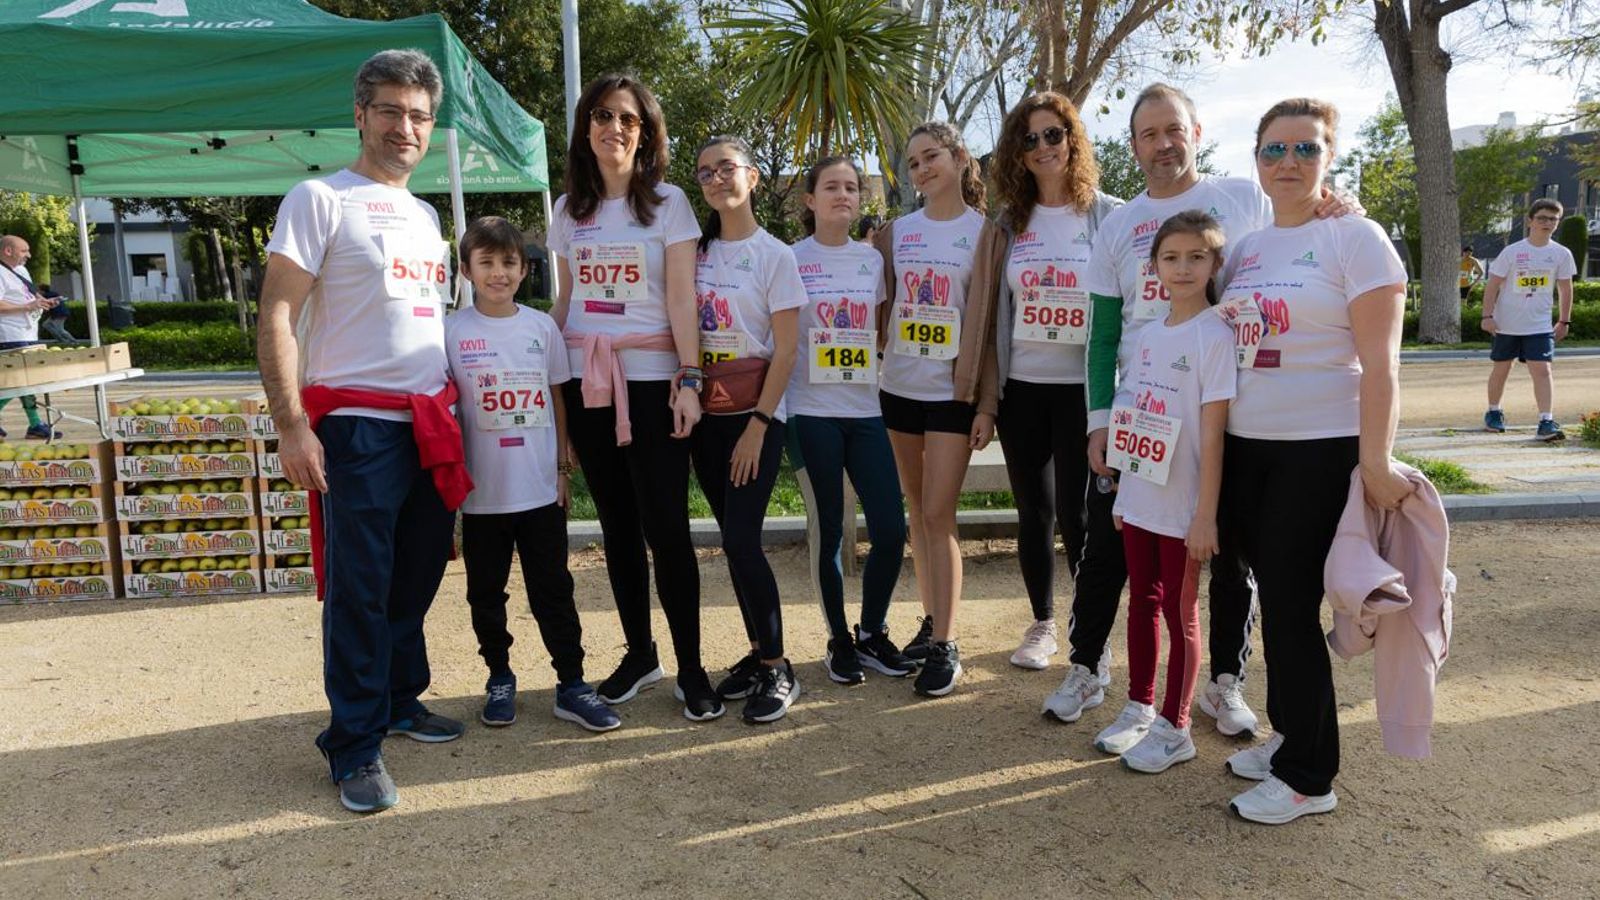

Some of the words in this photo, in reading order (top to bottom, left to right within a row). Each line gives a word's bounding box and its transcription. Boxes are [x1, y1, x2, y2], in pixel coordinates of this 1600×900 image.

[392, 257, 446, 284] 5076
[579, 264, 641, 285] 5075
[1521, 276, 1545, 287] 381
[1023, 305, 1085, 328] 5088
[906, 322, 946, 344] 198
[825, 347, 866, 367] 184
[483, 389, 546, 412] 5074
[1114, 429, 1167, 463] 5069
